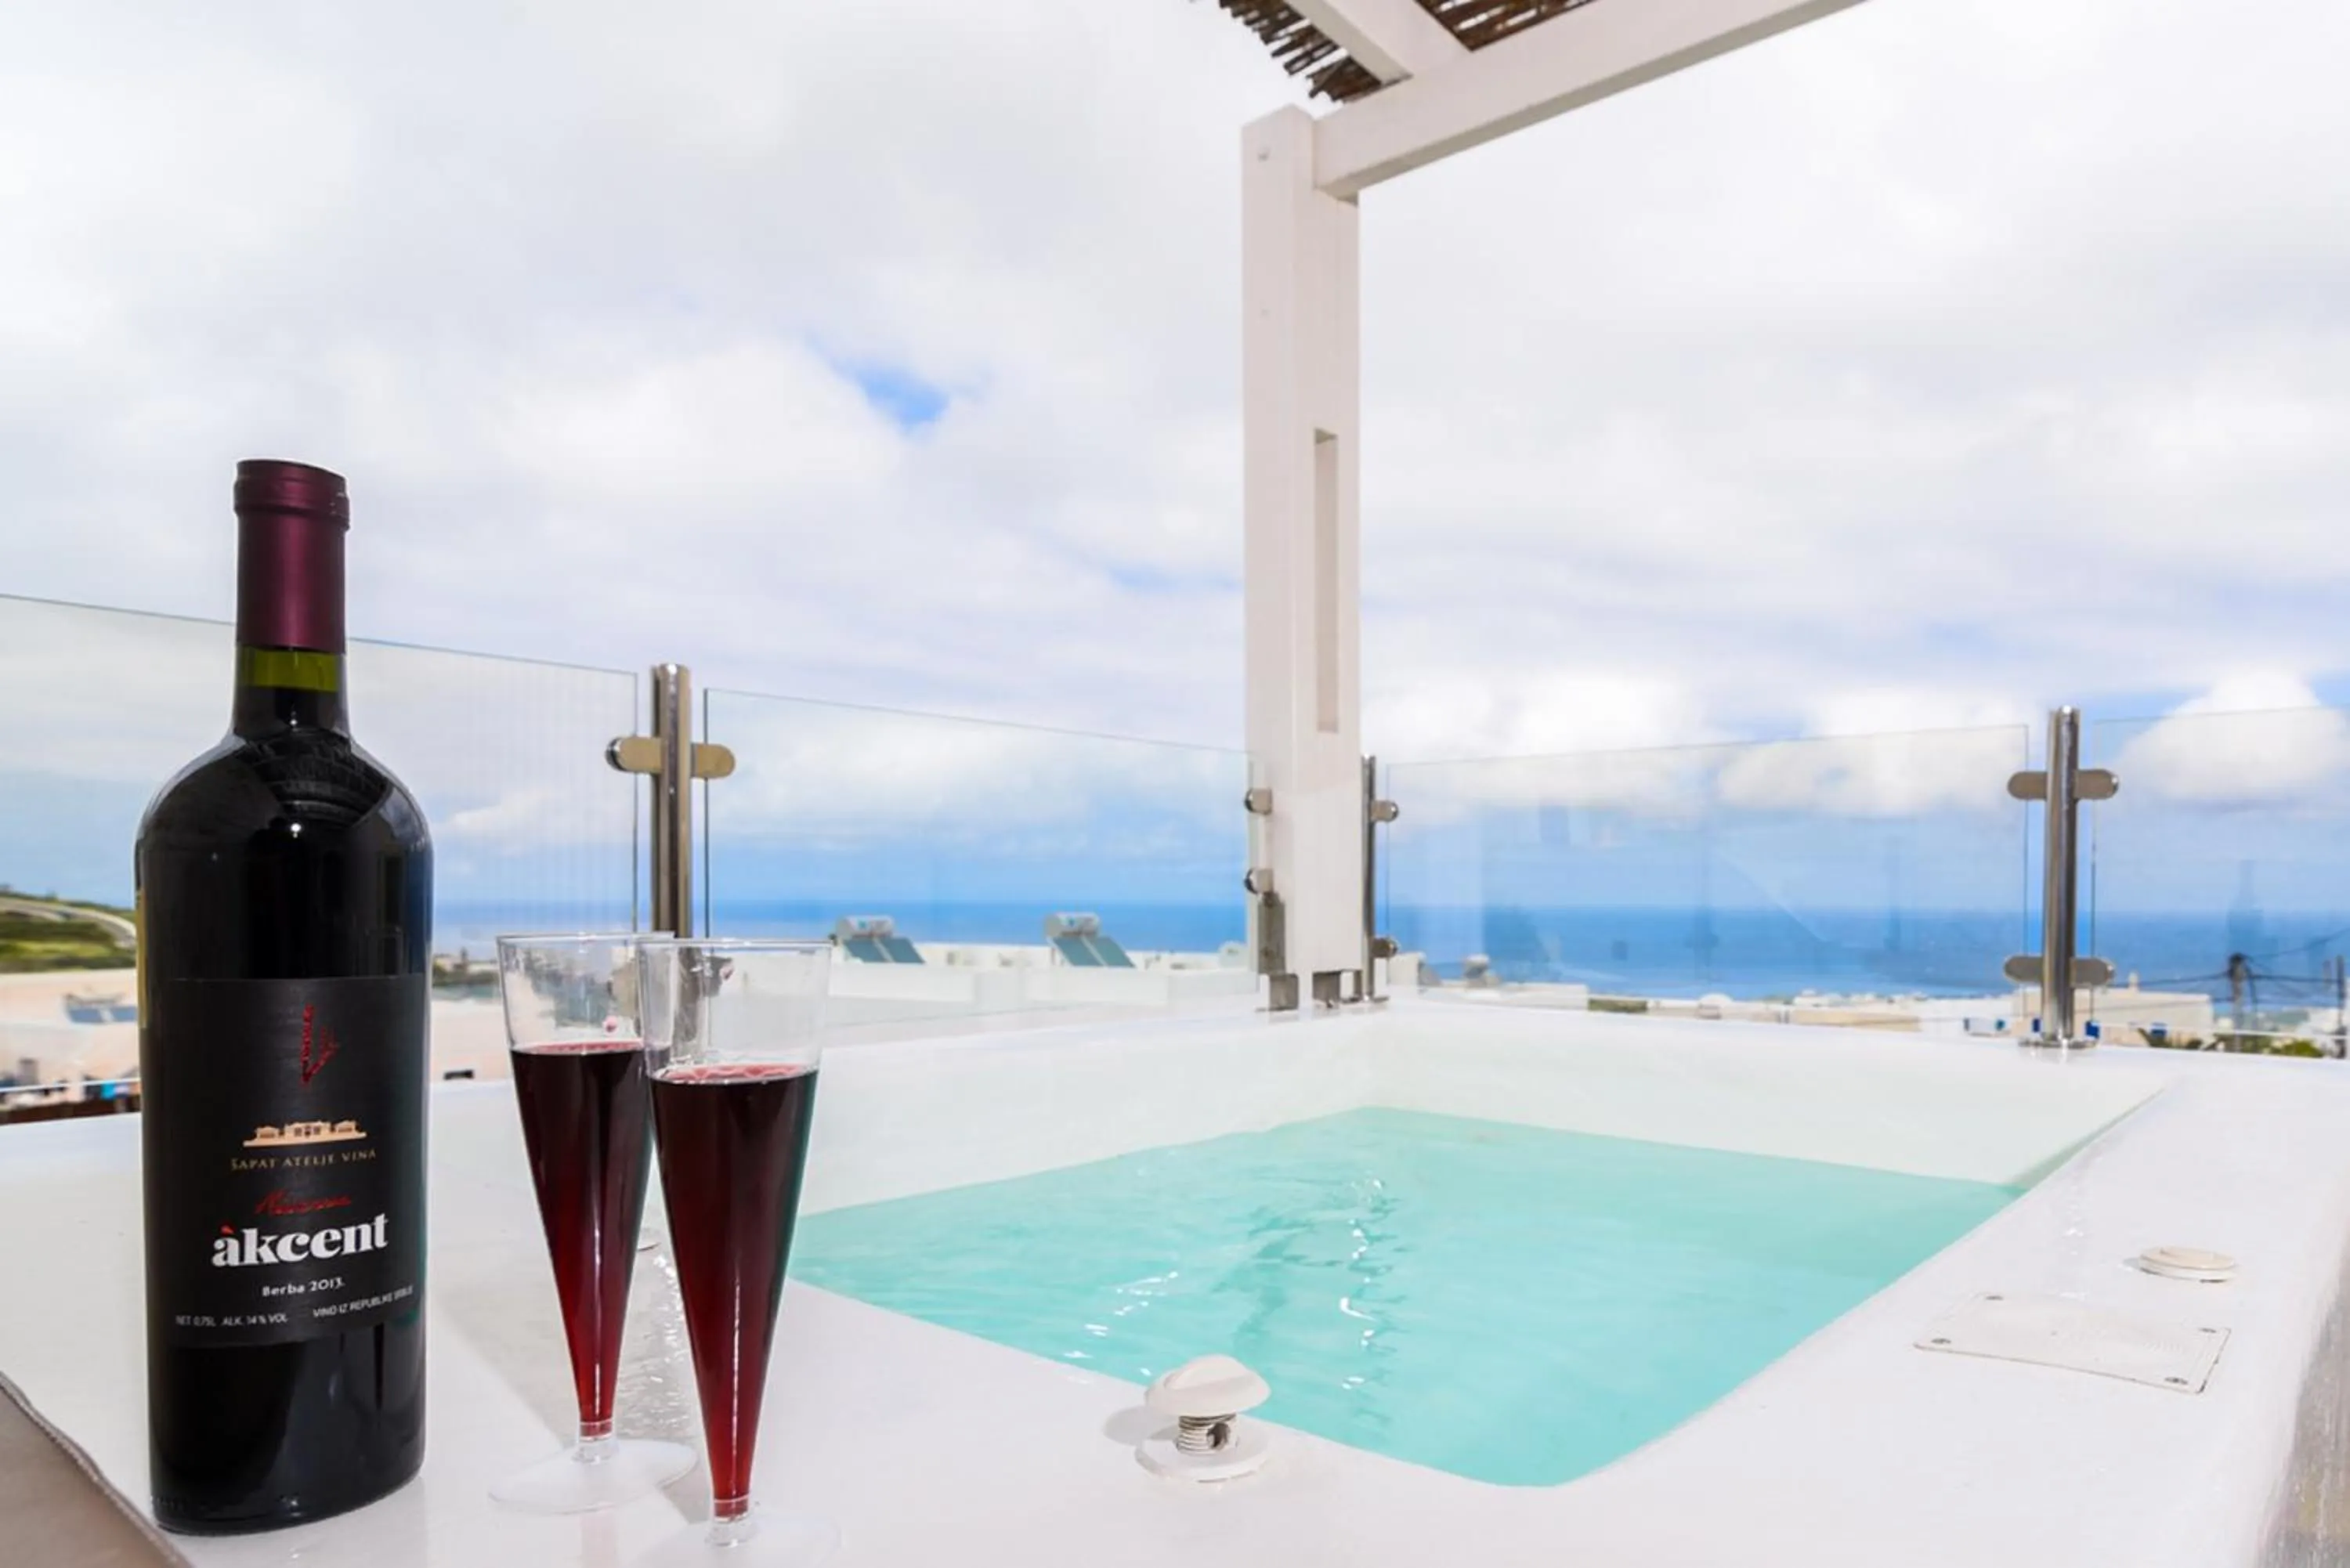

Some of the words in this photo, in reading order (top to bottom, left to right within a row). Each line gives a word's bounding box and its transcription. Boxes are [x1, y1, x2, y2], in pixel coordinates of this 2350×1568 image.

[282, 1153, 334, 1168] ATELJE
[342, 1148, 377, 1162] VINA
[262, 1282, 305, 1297] Berba
[313, 1305, 338, 1317] VINO
